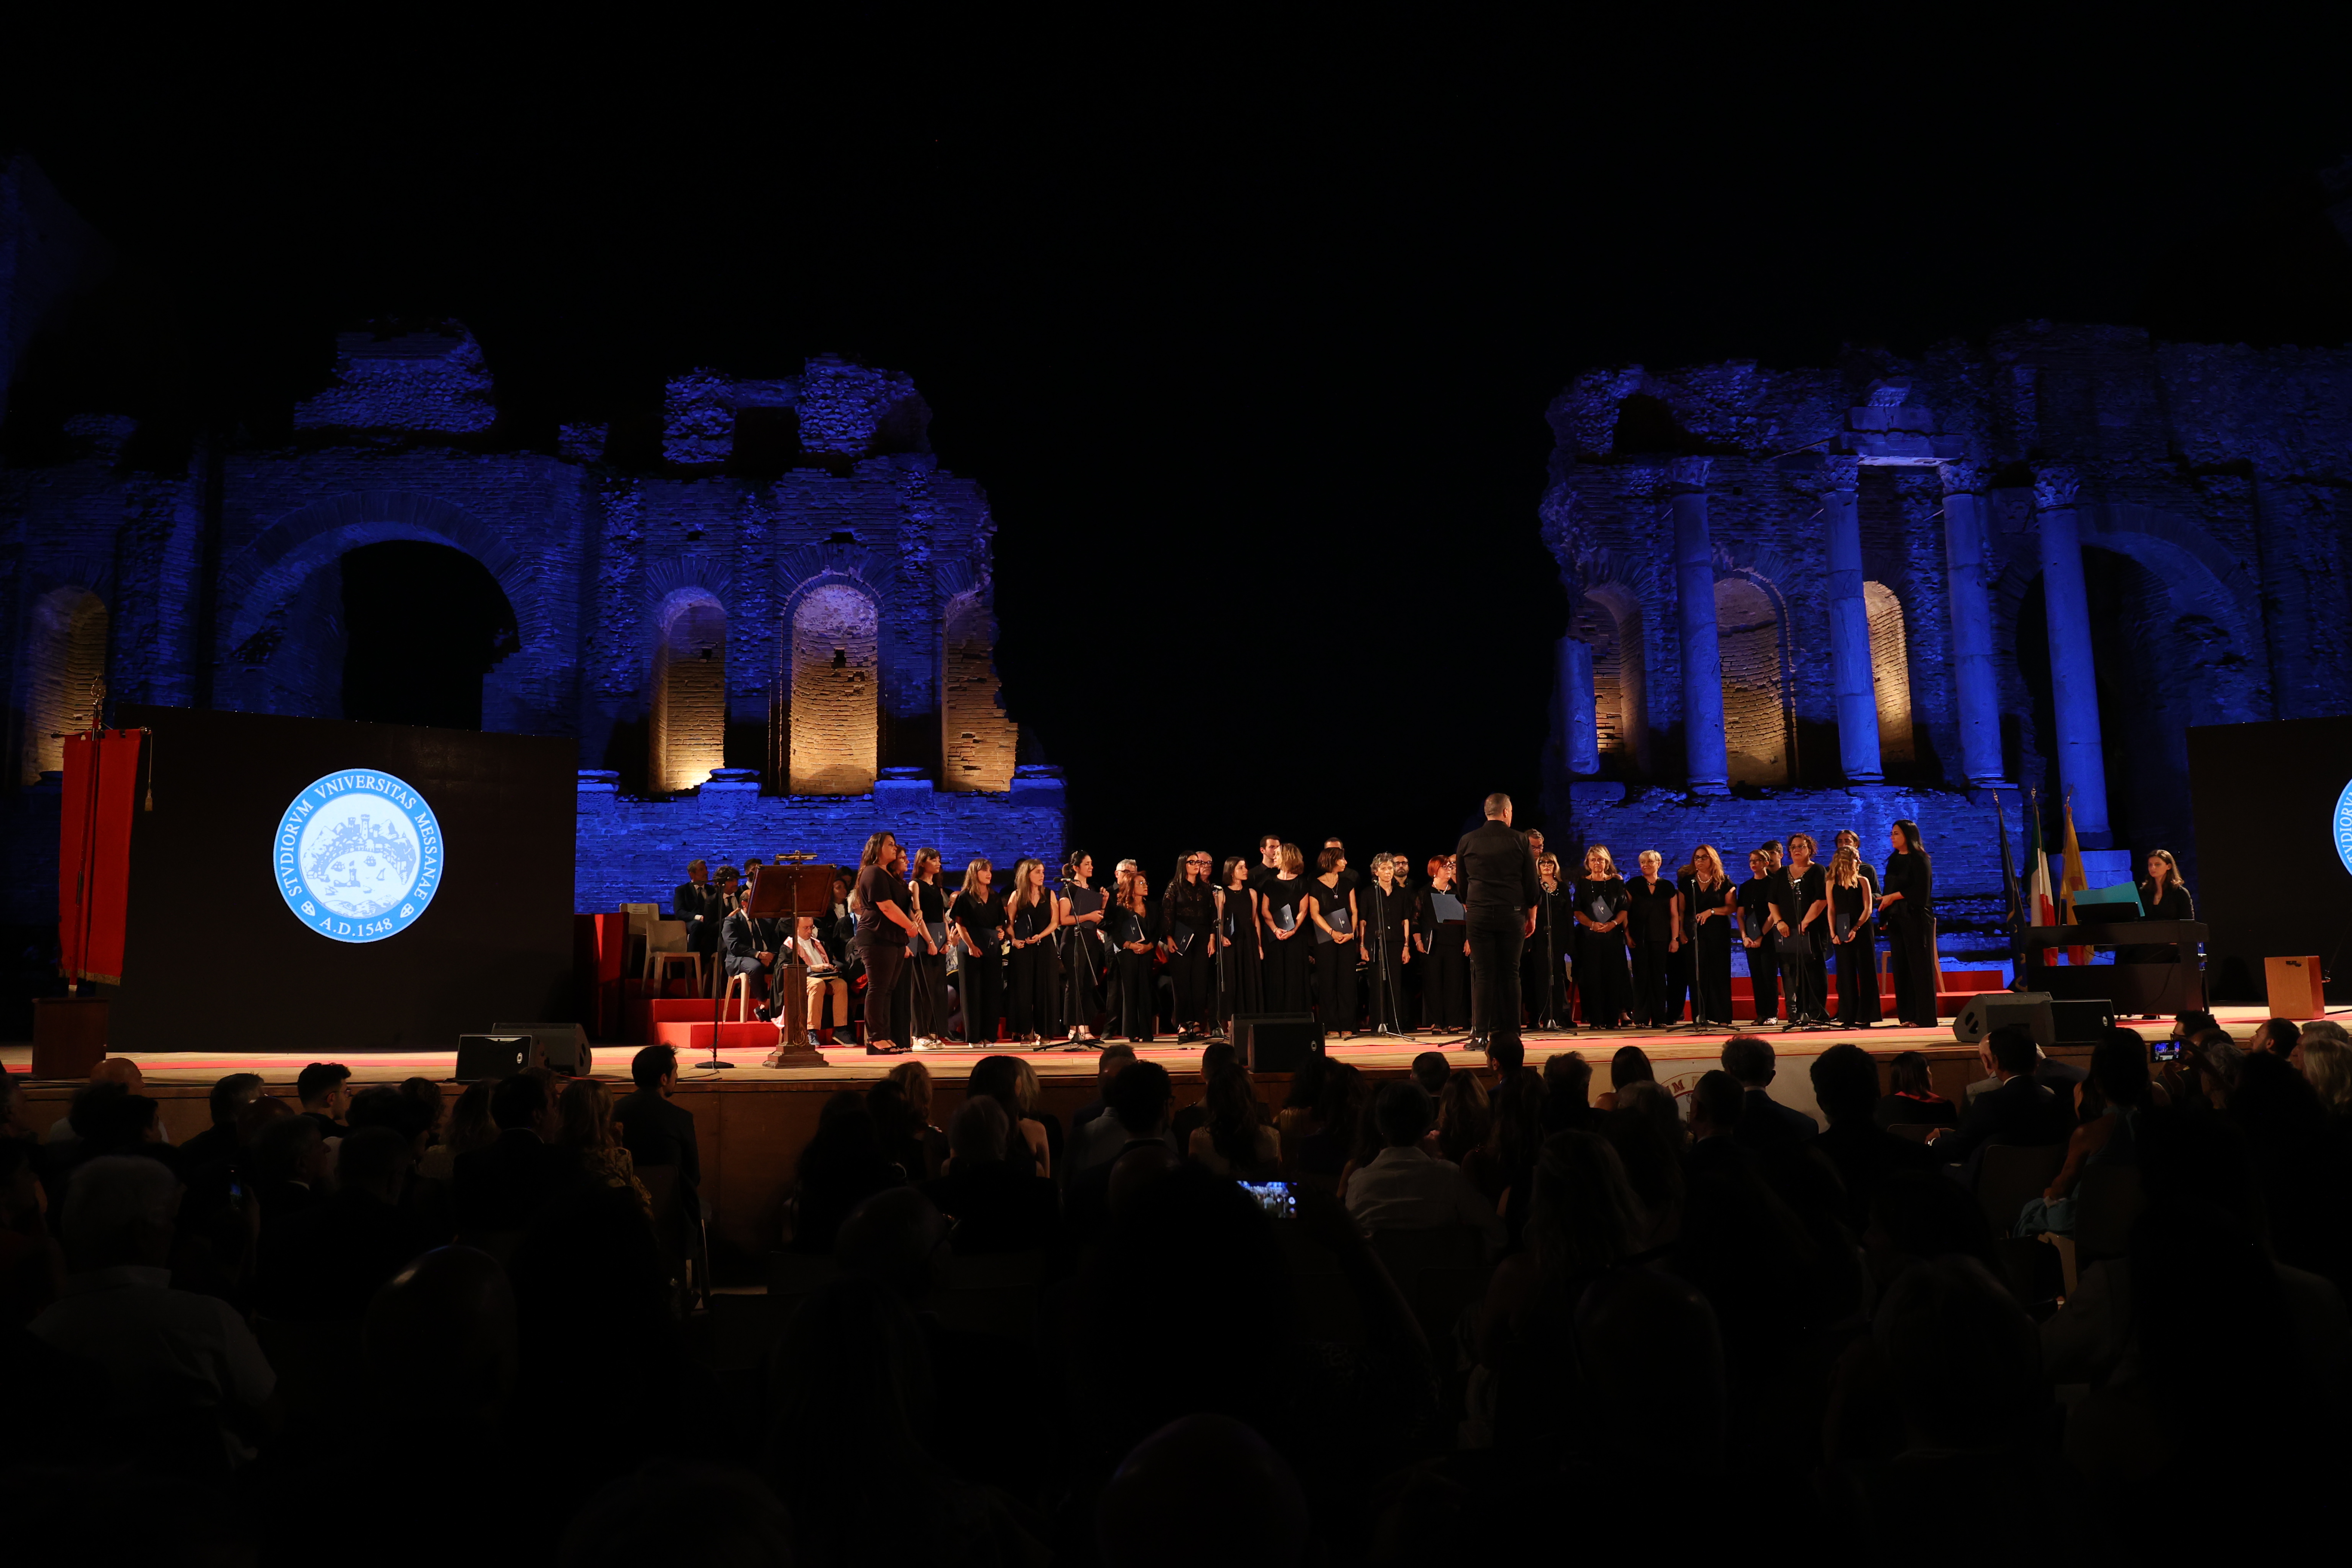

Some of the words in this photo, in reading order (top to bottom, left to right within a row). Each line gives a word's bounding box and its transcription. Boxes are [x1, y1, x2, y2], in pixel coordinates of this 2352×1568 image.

[280, 799, 314, 897] STVDIORVM
[314, 775, 416, 809] VNIVERSITAS
[414, 812, 437, 900] MESSANAE
